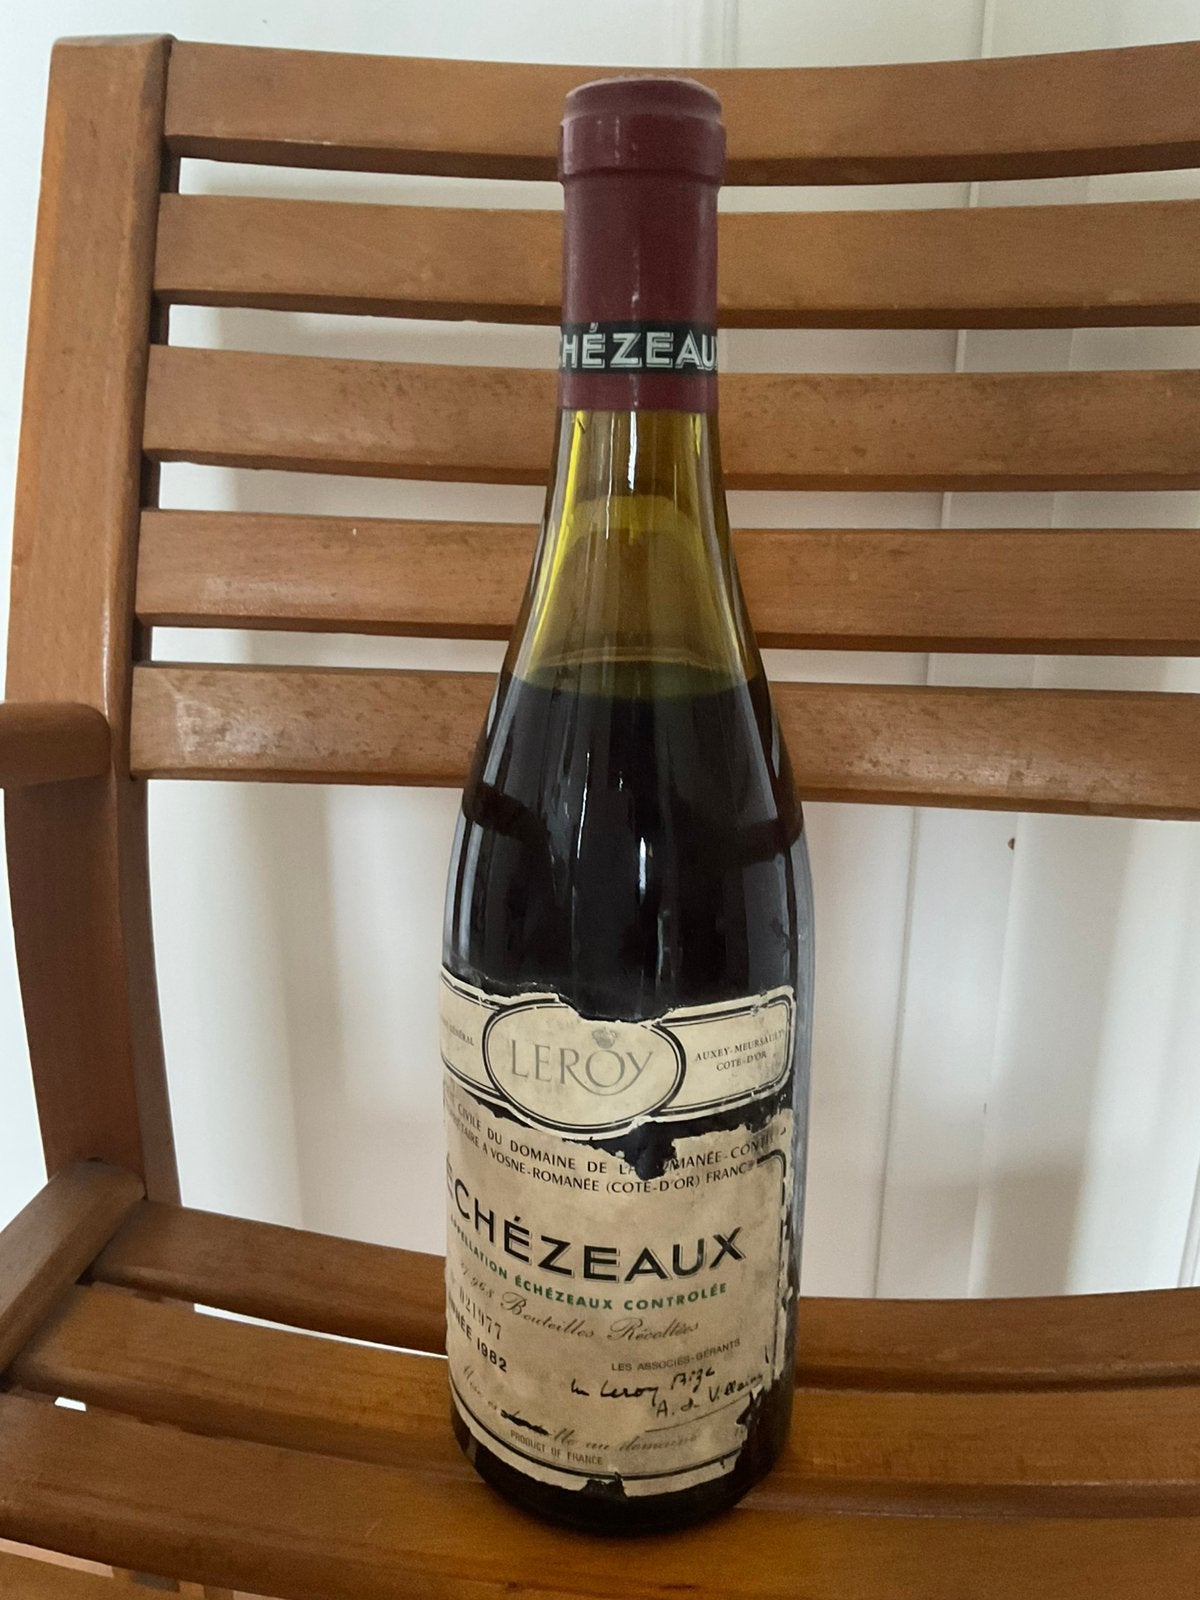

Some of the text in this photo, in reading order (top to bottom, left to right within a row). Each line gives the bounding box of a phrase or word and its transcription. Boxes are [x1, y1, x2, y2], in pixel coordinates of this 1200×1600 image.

[561, 322, 717, 371] HÉZEAU
[511, 1039, 654, 1096] LEROY
[487, 1127, 503, 1146] DU
[510, 1139, 576, 1171] DOMAINE
[587, 1160, 607, 1174] DE
[490, 1147, 600, 1193] VOSNE-ROMANÉE
[500, 1291, 594, 1338] Bouteilles
[514, 1274, 613, 1310] ÉCHÉZEAUX
[623, 1282, 727, 1311] CONTROLÉE
[477, 1337, 507, 1373] 1982
[611, 1362, 632, 1372] LES
